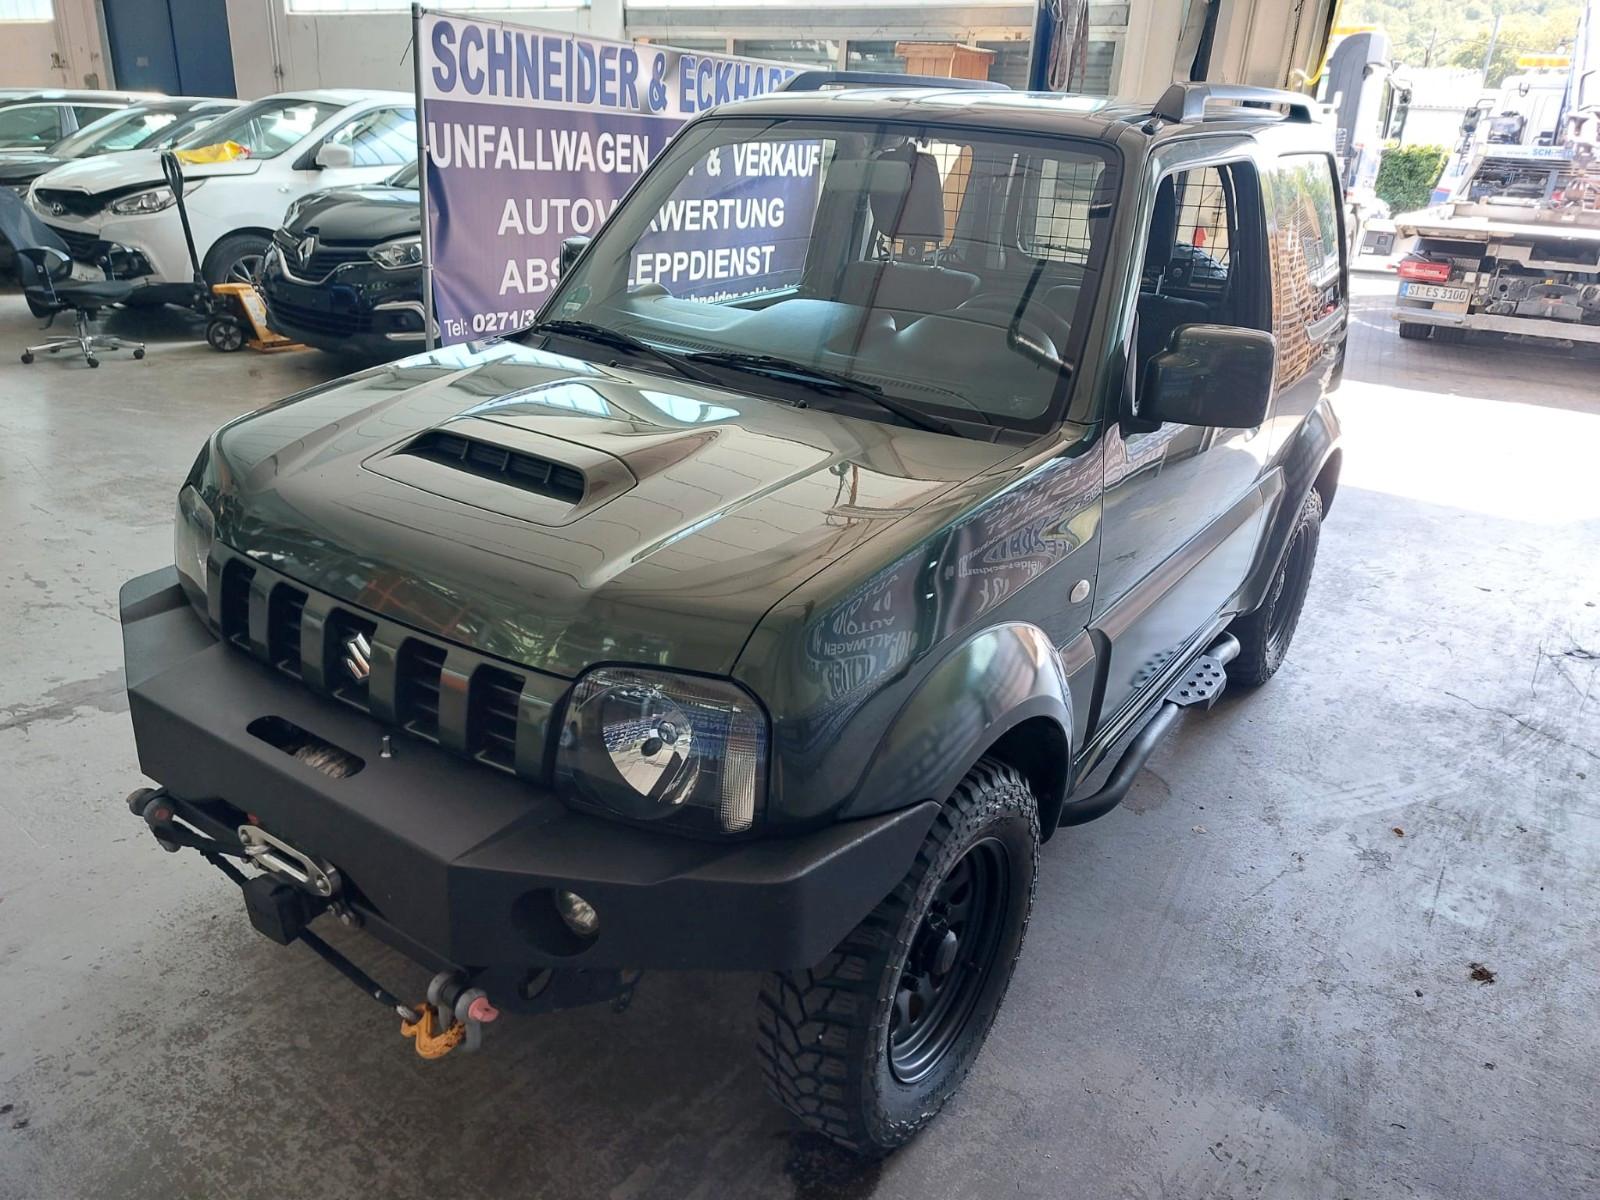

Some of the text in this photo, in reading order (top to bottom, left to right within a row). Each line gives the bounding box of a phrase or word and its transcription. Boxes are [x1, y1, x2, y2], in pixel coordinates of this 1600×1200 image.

[431, 20, 796, 113] SCHNEIDER & ECKHAR
[428, 121, 649, 174] UNFALLWAGEN
[706, 146, 721, 177] &
[732, 142, 820, 178] VERKAUF
[498, 198, 785, 237] AUTOVWERTUNG
[498, 245, 776, 296] ABEPPDIENST
[1408, 284, 1420, 297] SI
[1426, 286, 1440, 300] ES
[443, 308, 540, 337] Tel: 0271/3
